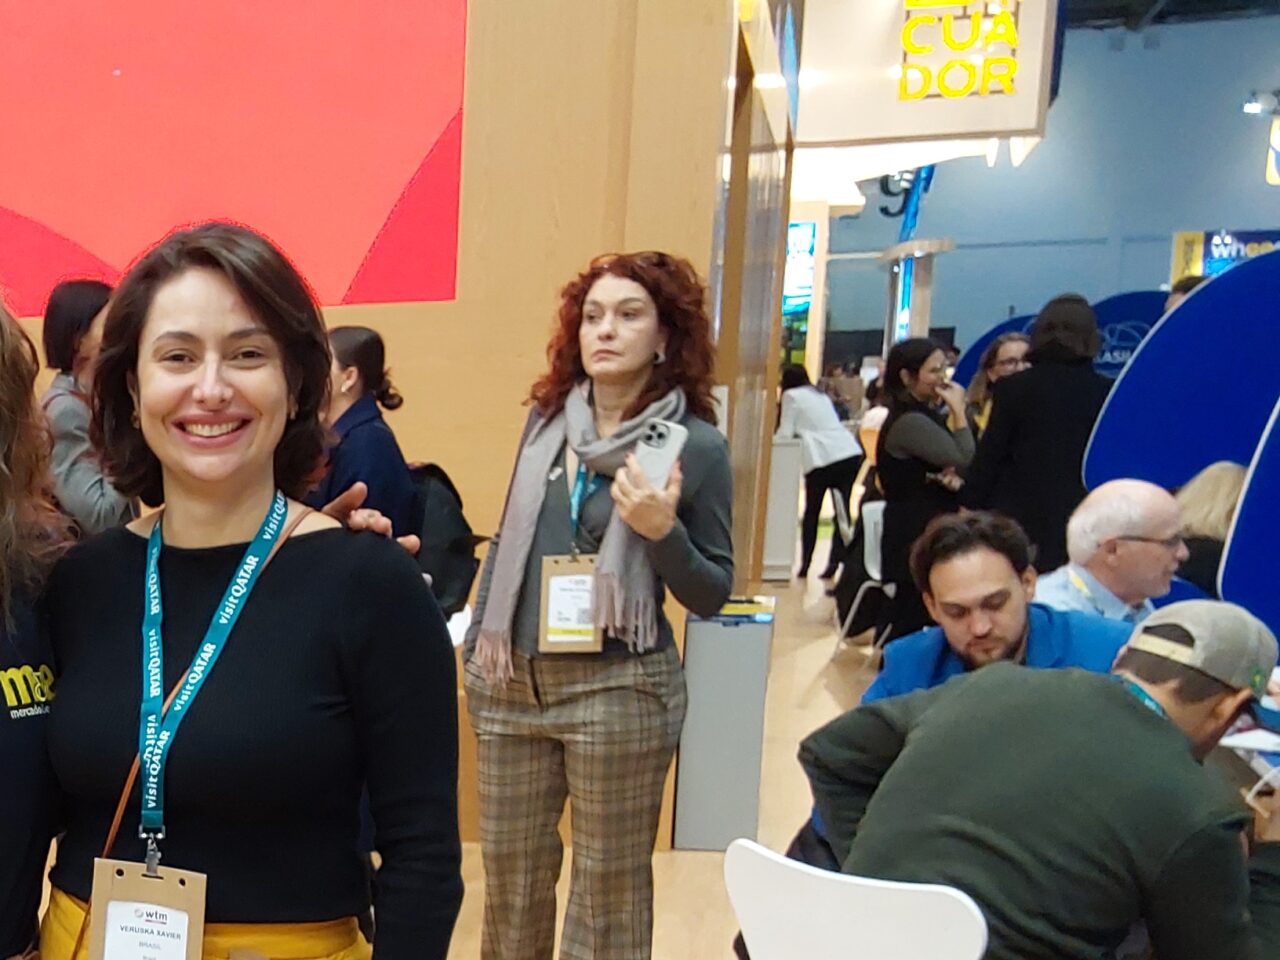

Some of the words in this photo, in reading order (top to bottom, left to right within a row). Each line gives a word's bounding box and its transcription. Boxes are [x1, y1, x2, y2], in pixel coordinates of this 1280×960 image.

[899, 57, 1017, 101] DOR
[219, 555, 260, 625] visitQATAR
[148, 628, 161, 698] visitQATAR
[174, 642, 217, 711] visitQATAR
[146, 730, 170, 808] visitQATAR
[120, 925, 155, 936] VERUSKA
[156, 930, 181, 940] XAVIER
[145, 910, 168, 921] wtm
